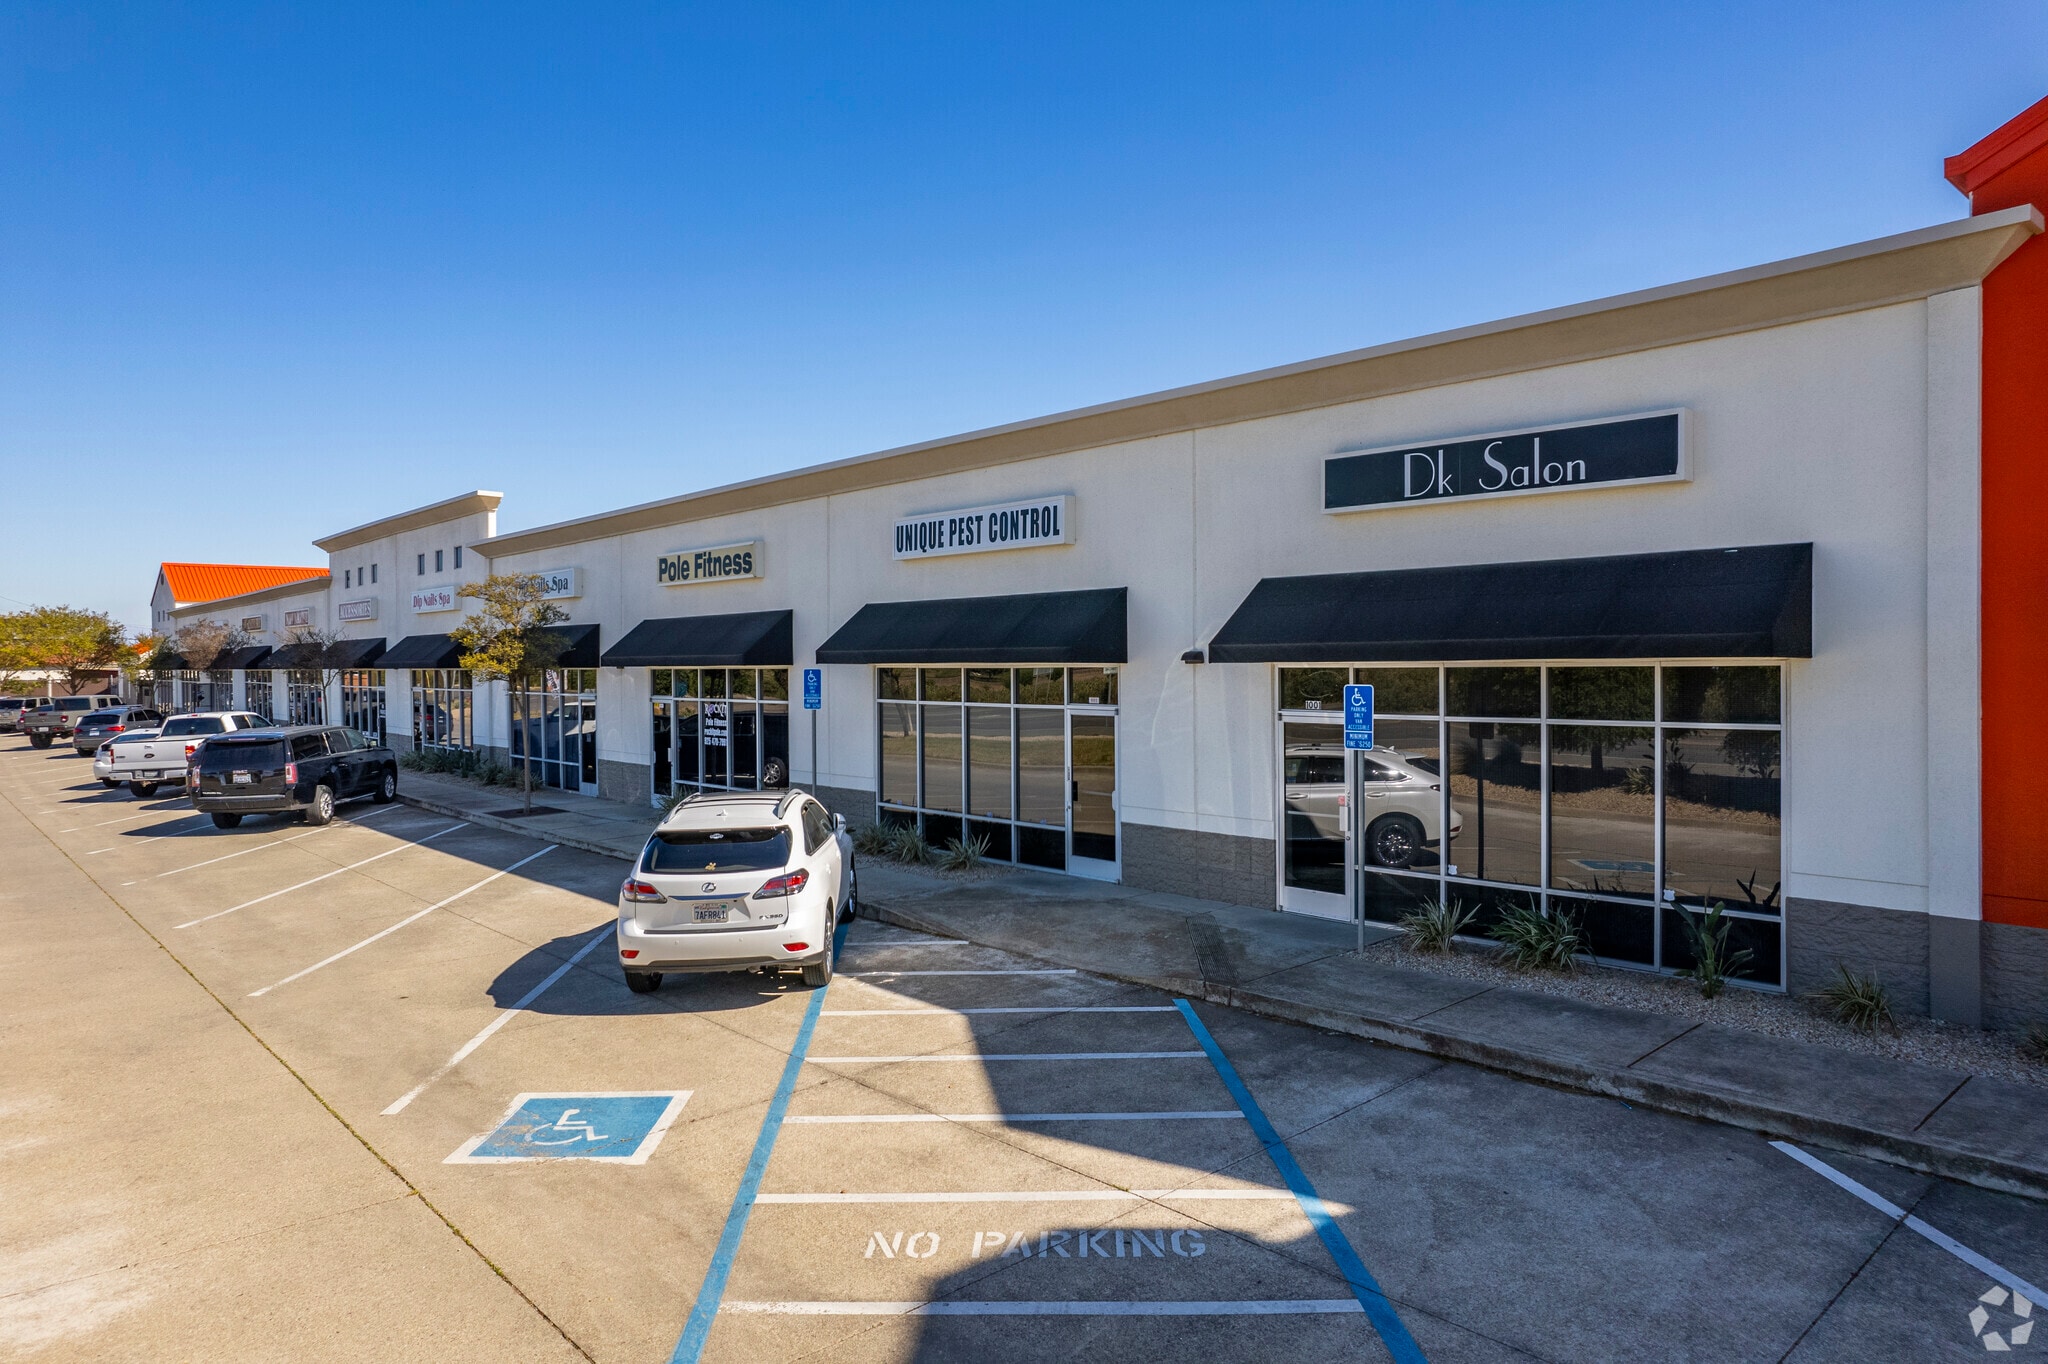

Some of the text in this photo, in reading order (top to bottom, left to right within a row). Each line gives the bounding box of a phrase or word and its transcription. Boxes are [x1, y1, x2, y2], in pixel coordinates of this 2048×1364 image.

[1404, 436, 1586, 498] Dk Salon
[896, 505, 1060, 553] UNIQUE PEST CONTROL
[658, 551, 753, 582] Pole Fitness
[550, 576, 569, 594] Spa
[413, 592, 450, 609] Dip Nails Spa
[1306, 701, 1321, 709] 1001
[863, 1229, 1206, 1259] NO PARKING
